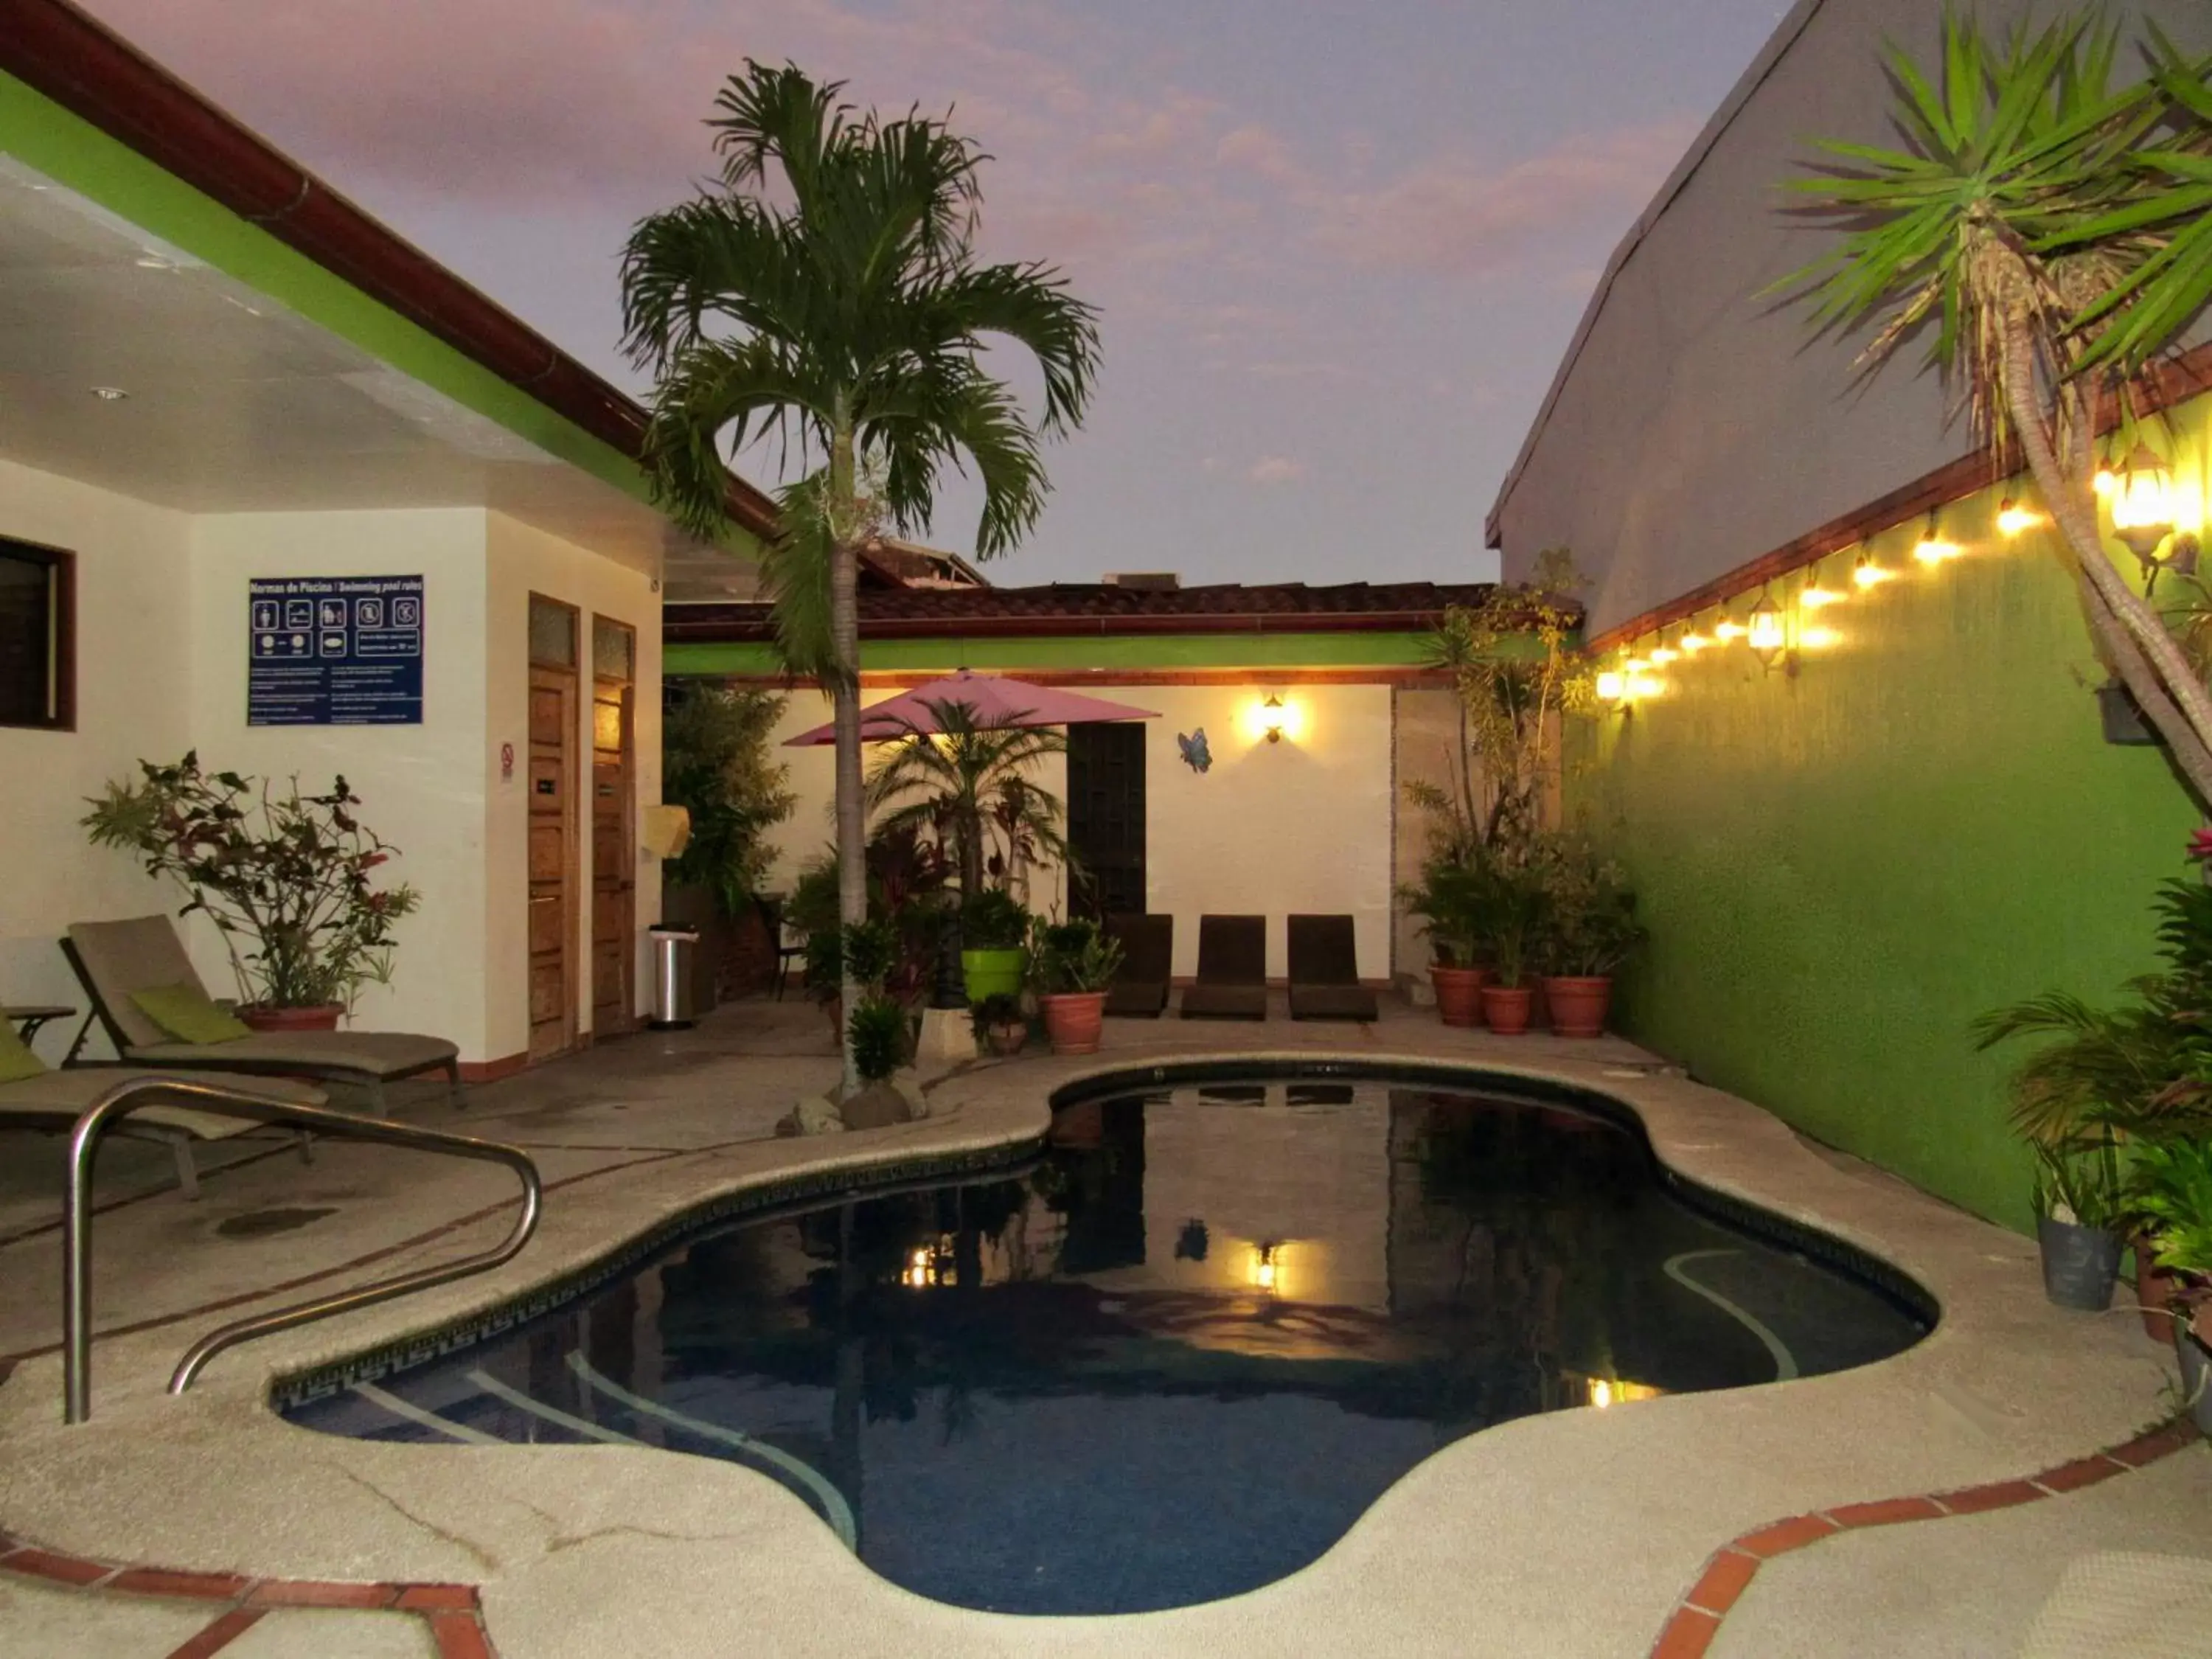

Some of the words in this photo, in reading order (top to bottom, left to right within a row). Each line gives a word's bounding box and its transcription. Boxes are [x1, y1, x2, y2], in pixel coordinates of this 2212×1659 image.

[251, 582, 285, 594] Normas
[287, 581, 298, 593] de
[300, 581, 332, 592] Piscina
